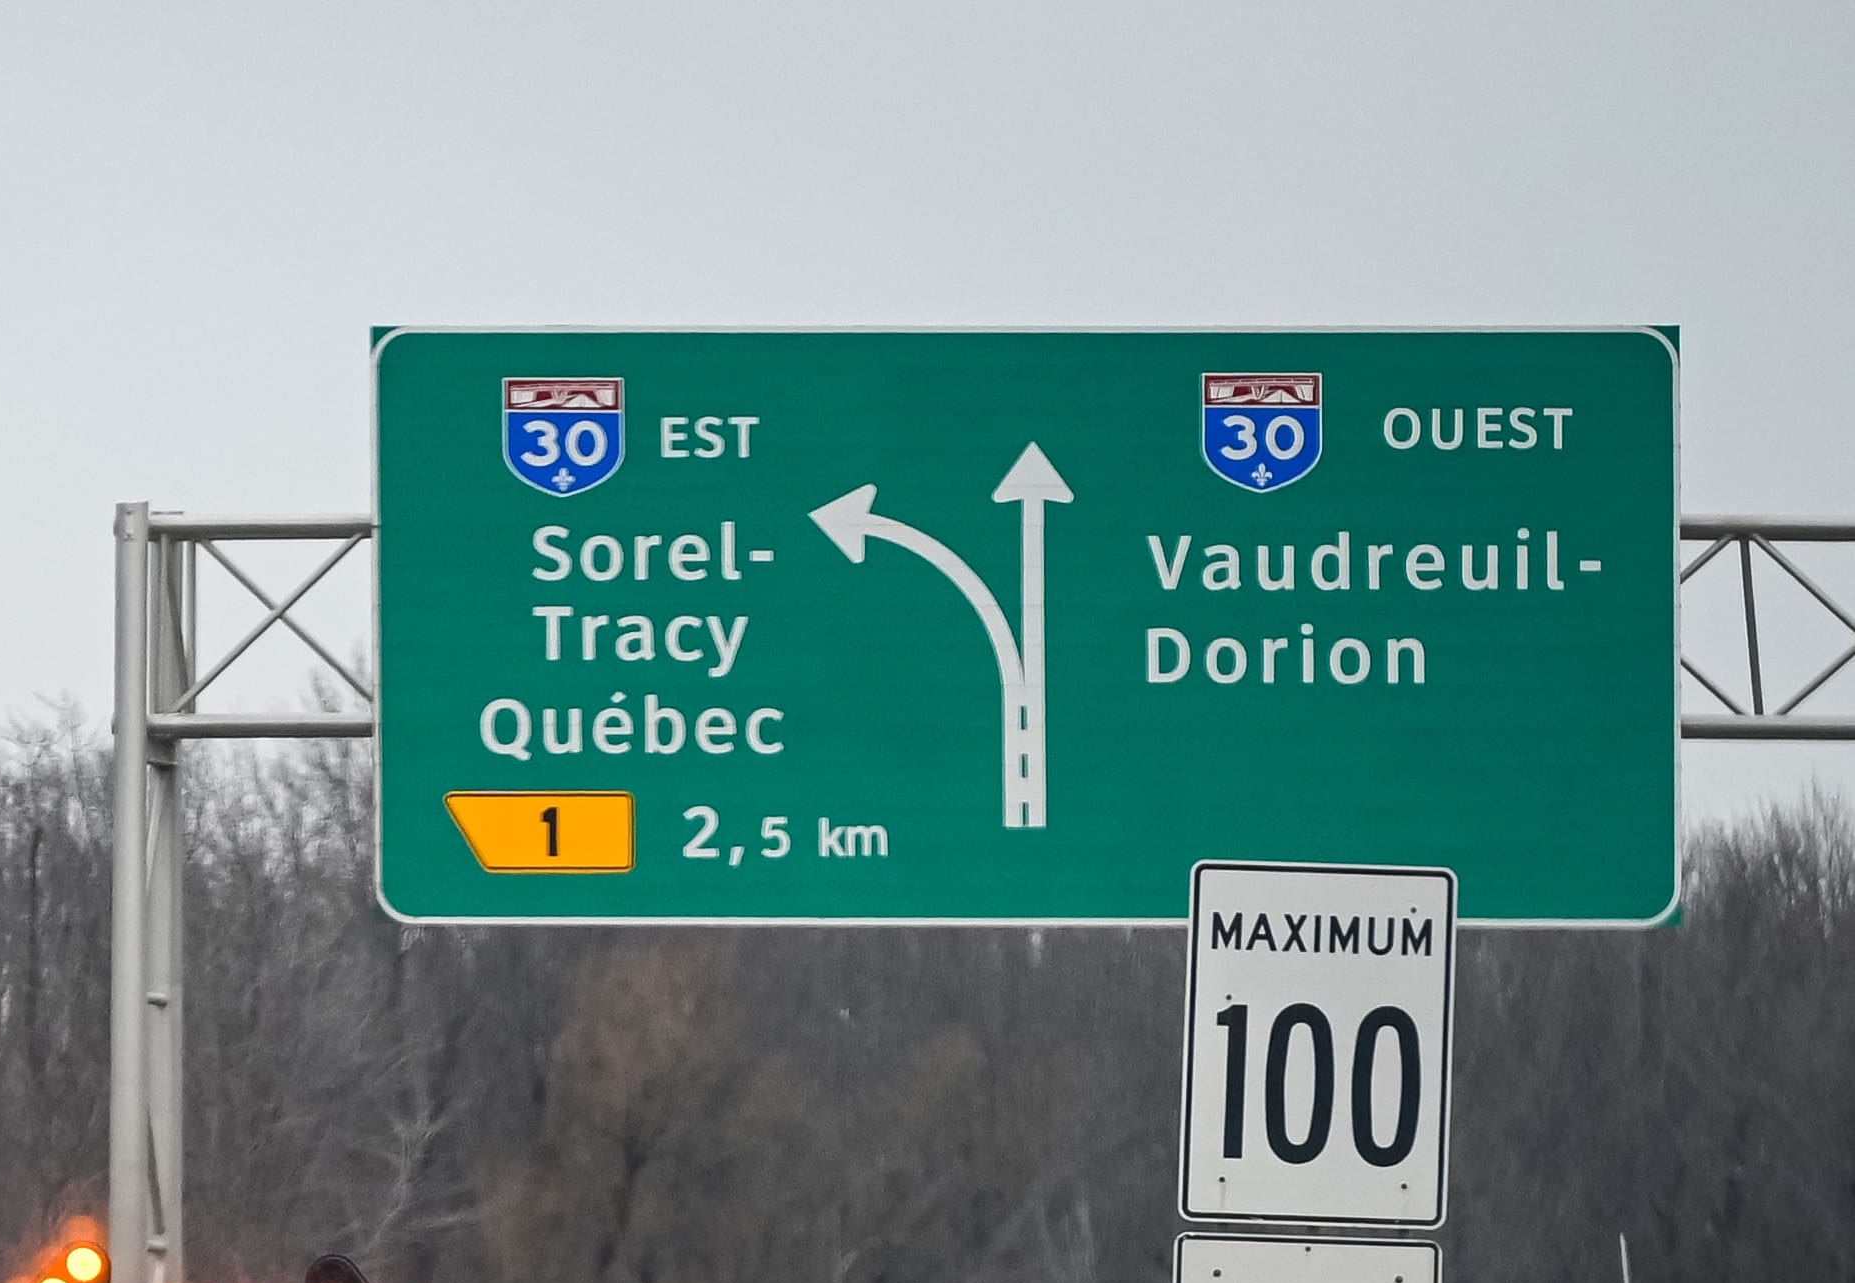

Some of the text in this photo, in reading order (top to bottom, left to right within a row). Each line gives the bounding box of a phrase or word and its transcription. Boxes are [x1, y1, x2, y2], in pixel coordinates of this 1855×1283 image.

[520, 416, 761, 467] 30 EST
[1220, 407, 1574, 461] 30 OUEST
[531, 521, 775, 582] Sorel-
[1147, 528, 1603, 592] Vaudreuil-
[531, 605, 750, 678] Tracy
[1146, 623, 1428, 685] Dorion
[478, 690, 786, 761] Québec
[540, 805, 560, 857] 1
[681, 805, 890, 867] 2,5 km
[1210, 911, 1434, 957] MAXIMUM
[1215, 1002, 1423, 1168] 100
